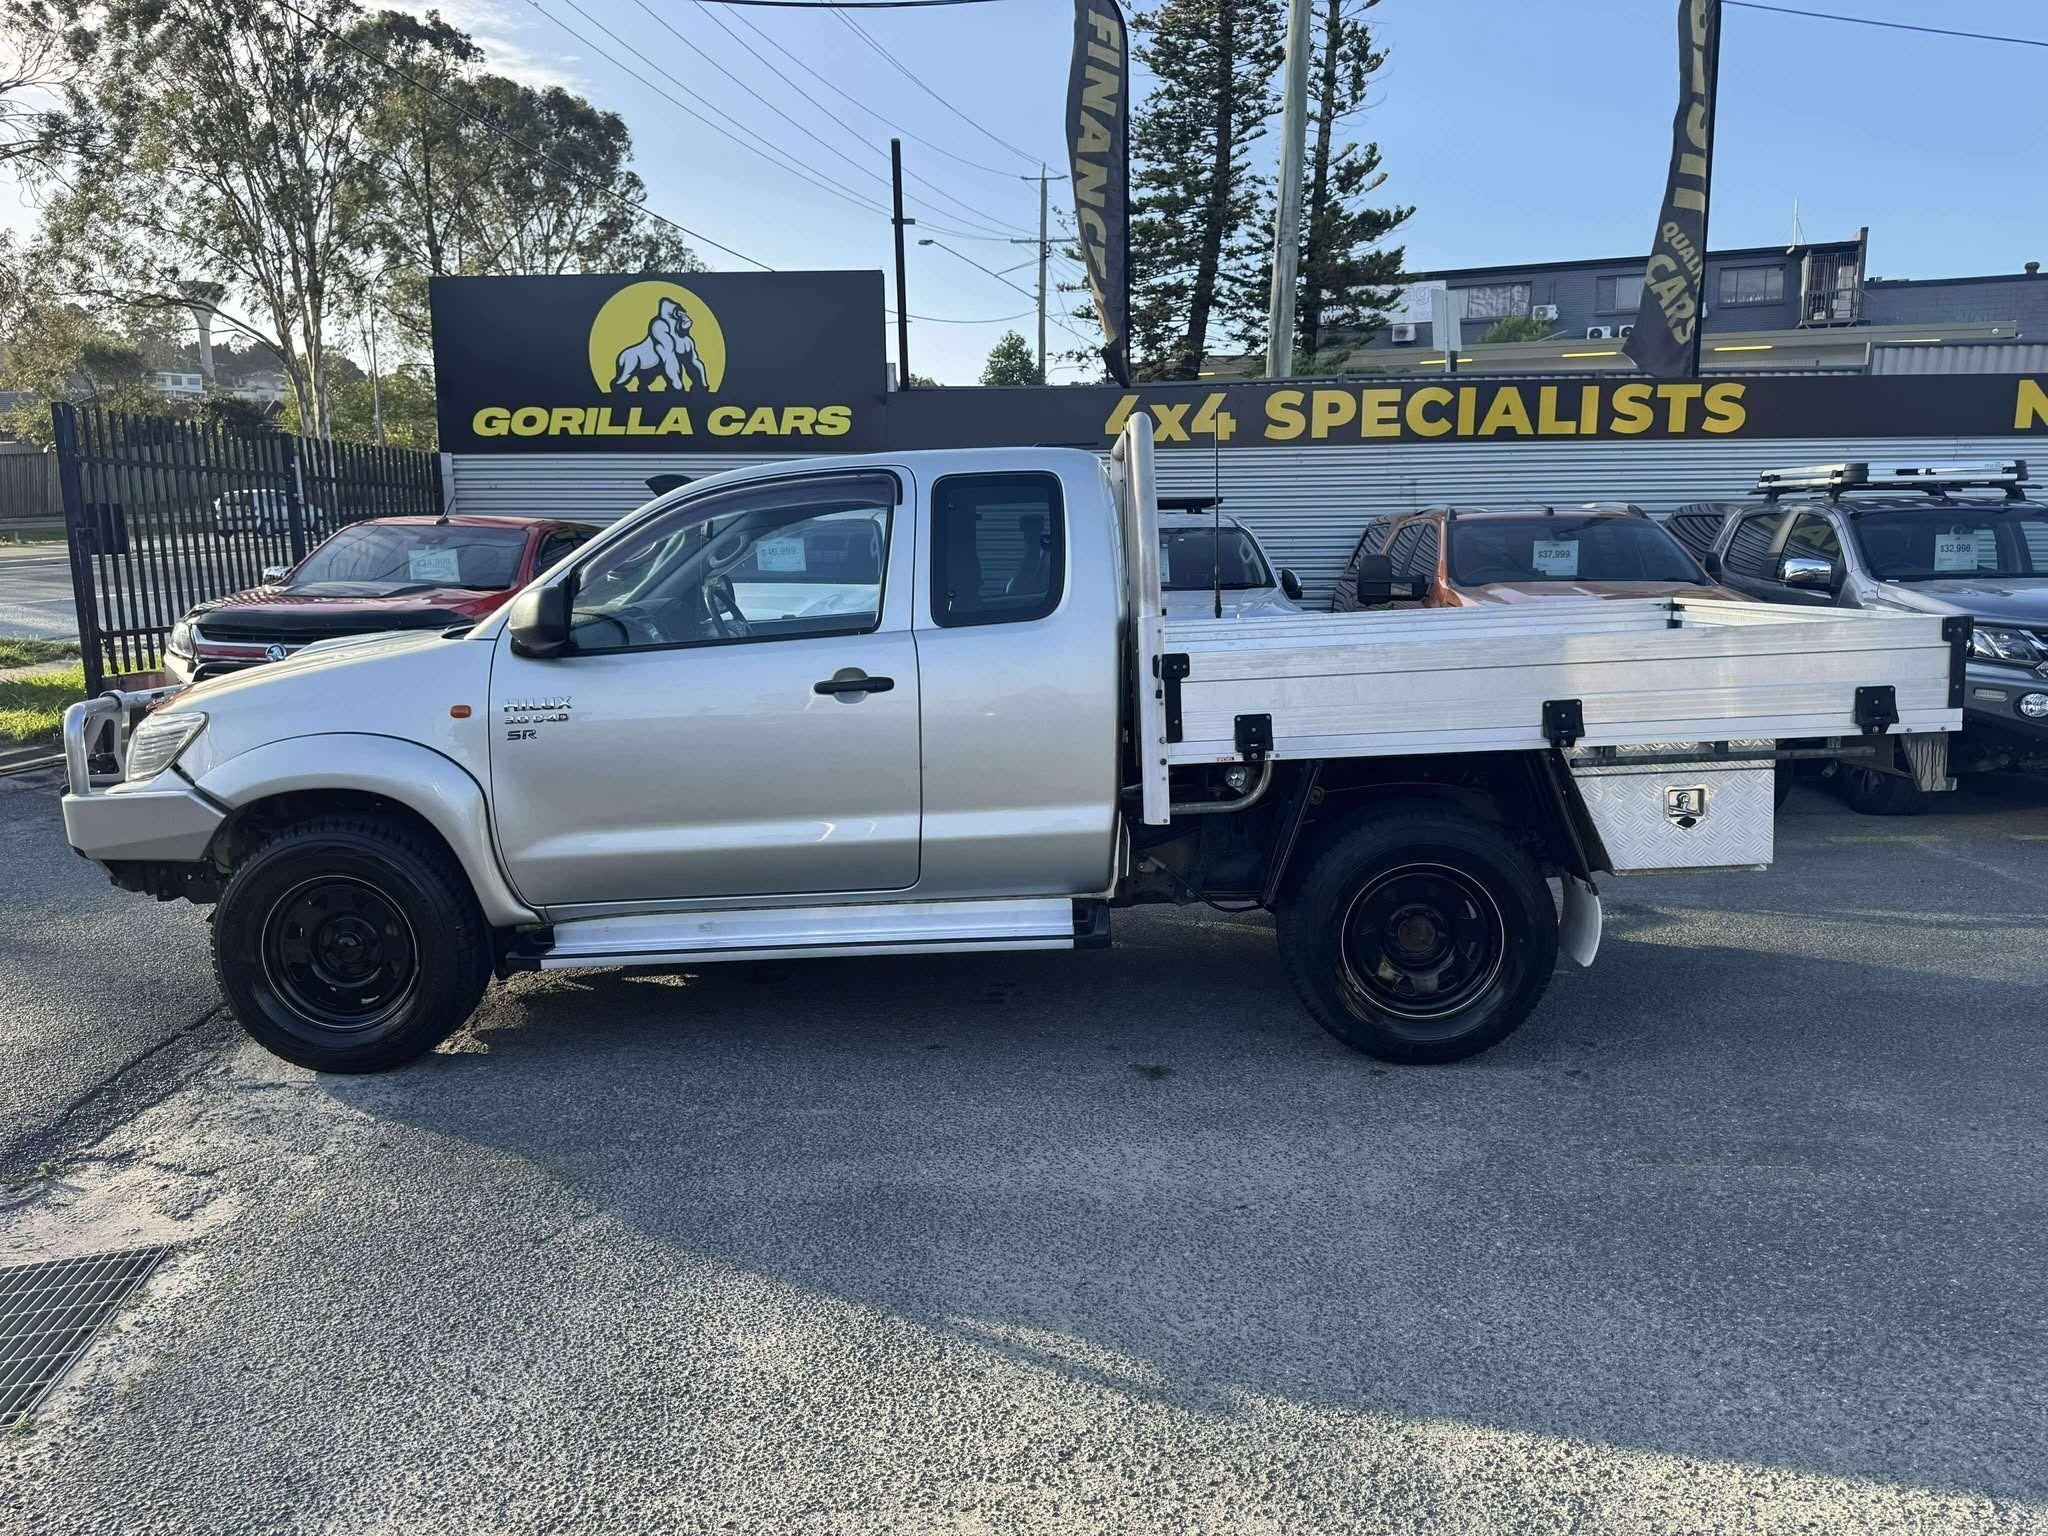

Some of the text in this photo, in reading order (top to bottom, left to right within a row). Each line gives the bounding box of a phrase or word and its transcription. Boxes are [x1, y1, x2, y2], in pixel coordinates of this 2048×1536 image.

[1662, 221, 1703, 286] QUALI
[1645, 254, 1697, 345] CARS
[472, 405, 852, 436] GORILLA CARS
[1104, 383, 1746, 442] 4x4 SPECIALISTS
[503, 695, 573, 713] HILUX
[506, 728, 538, 741] SR
